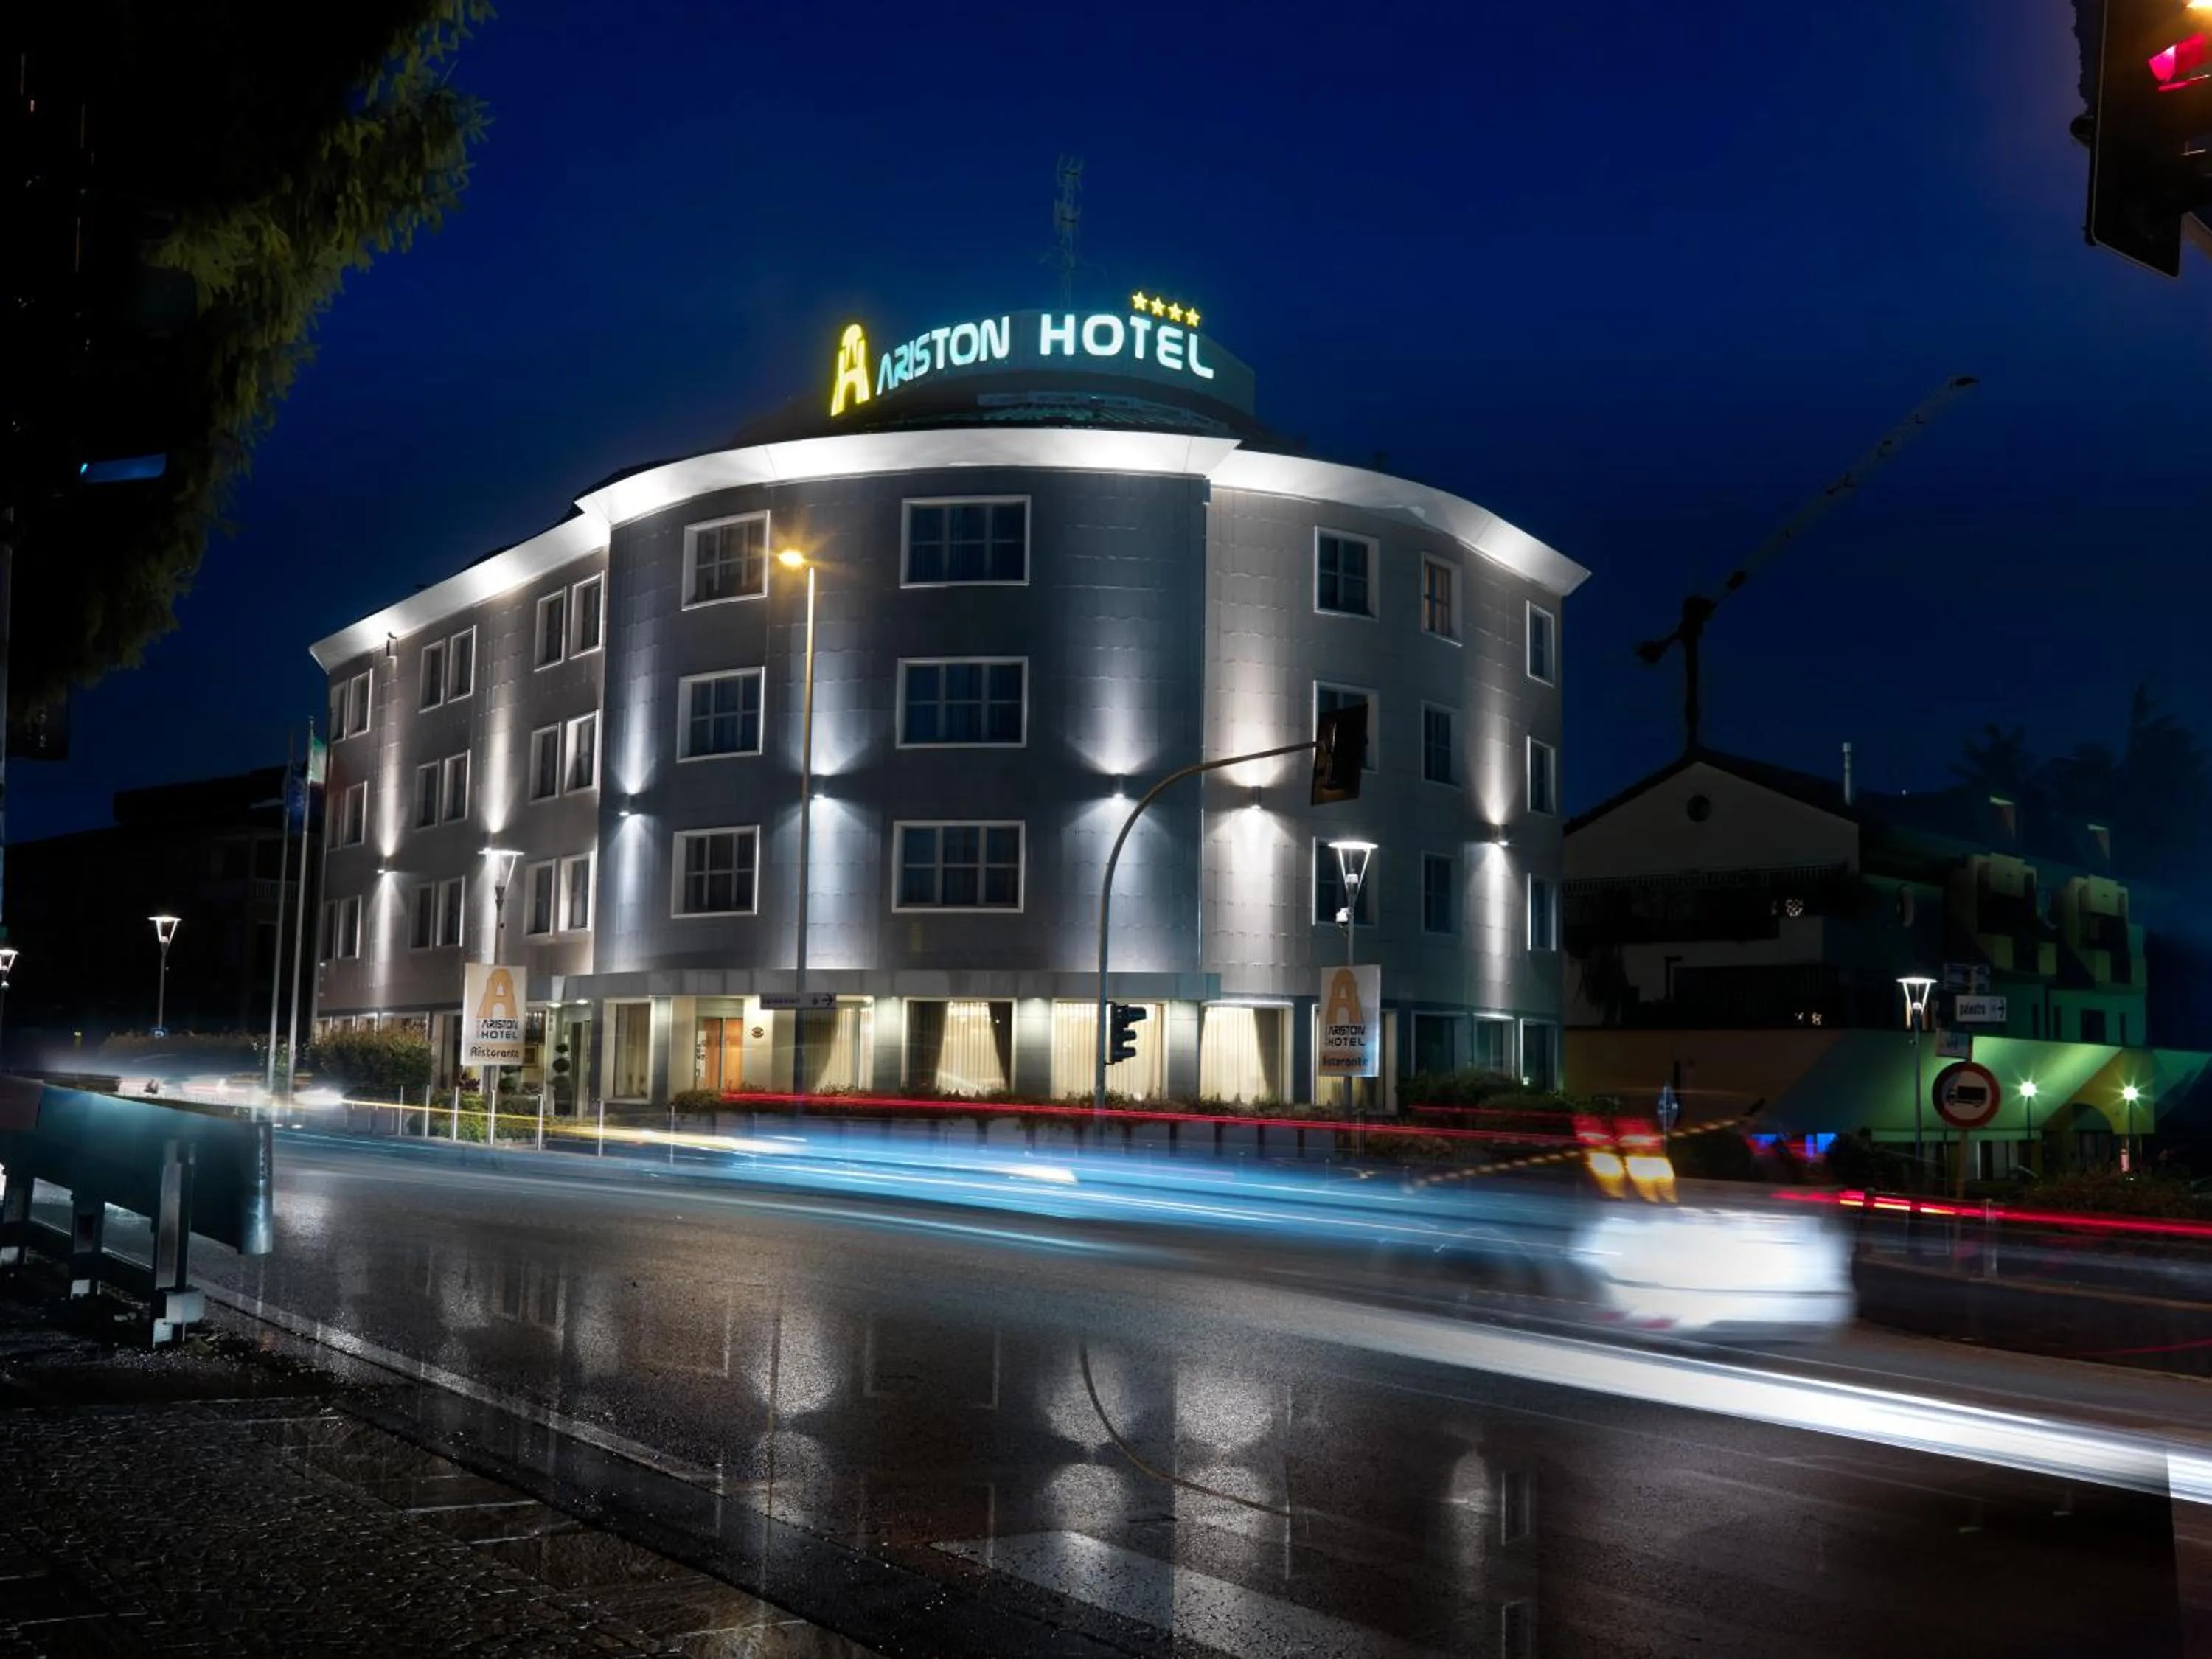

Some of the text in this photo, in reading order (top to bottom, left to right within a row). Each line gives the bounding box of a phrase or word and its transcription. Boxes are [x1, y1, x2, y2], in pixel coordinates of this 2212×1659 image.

[876, 313, 1214, 396] ARISTON HOTEL
[481, 1019, 518, 1029] ARISTON
[481, 1030, 518, 1039] HOTEL
[1328, 1026, 1366, 1036] ARISTON
[1328, 1037, 1366, 1046] HOTEL
[470, 1046, 519, 1058] Ristorante
